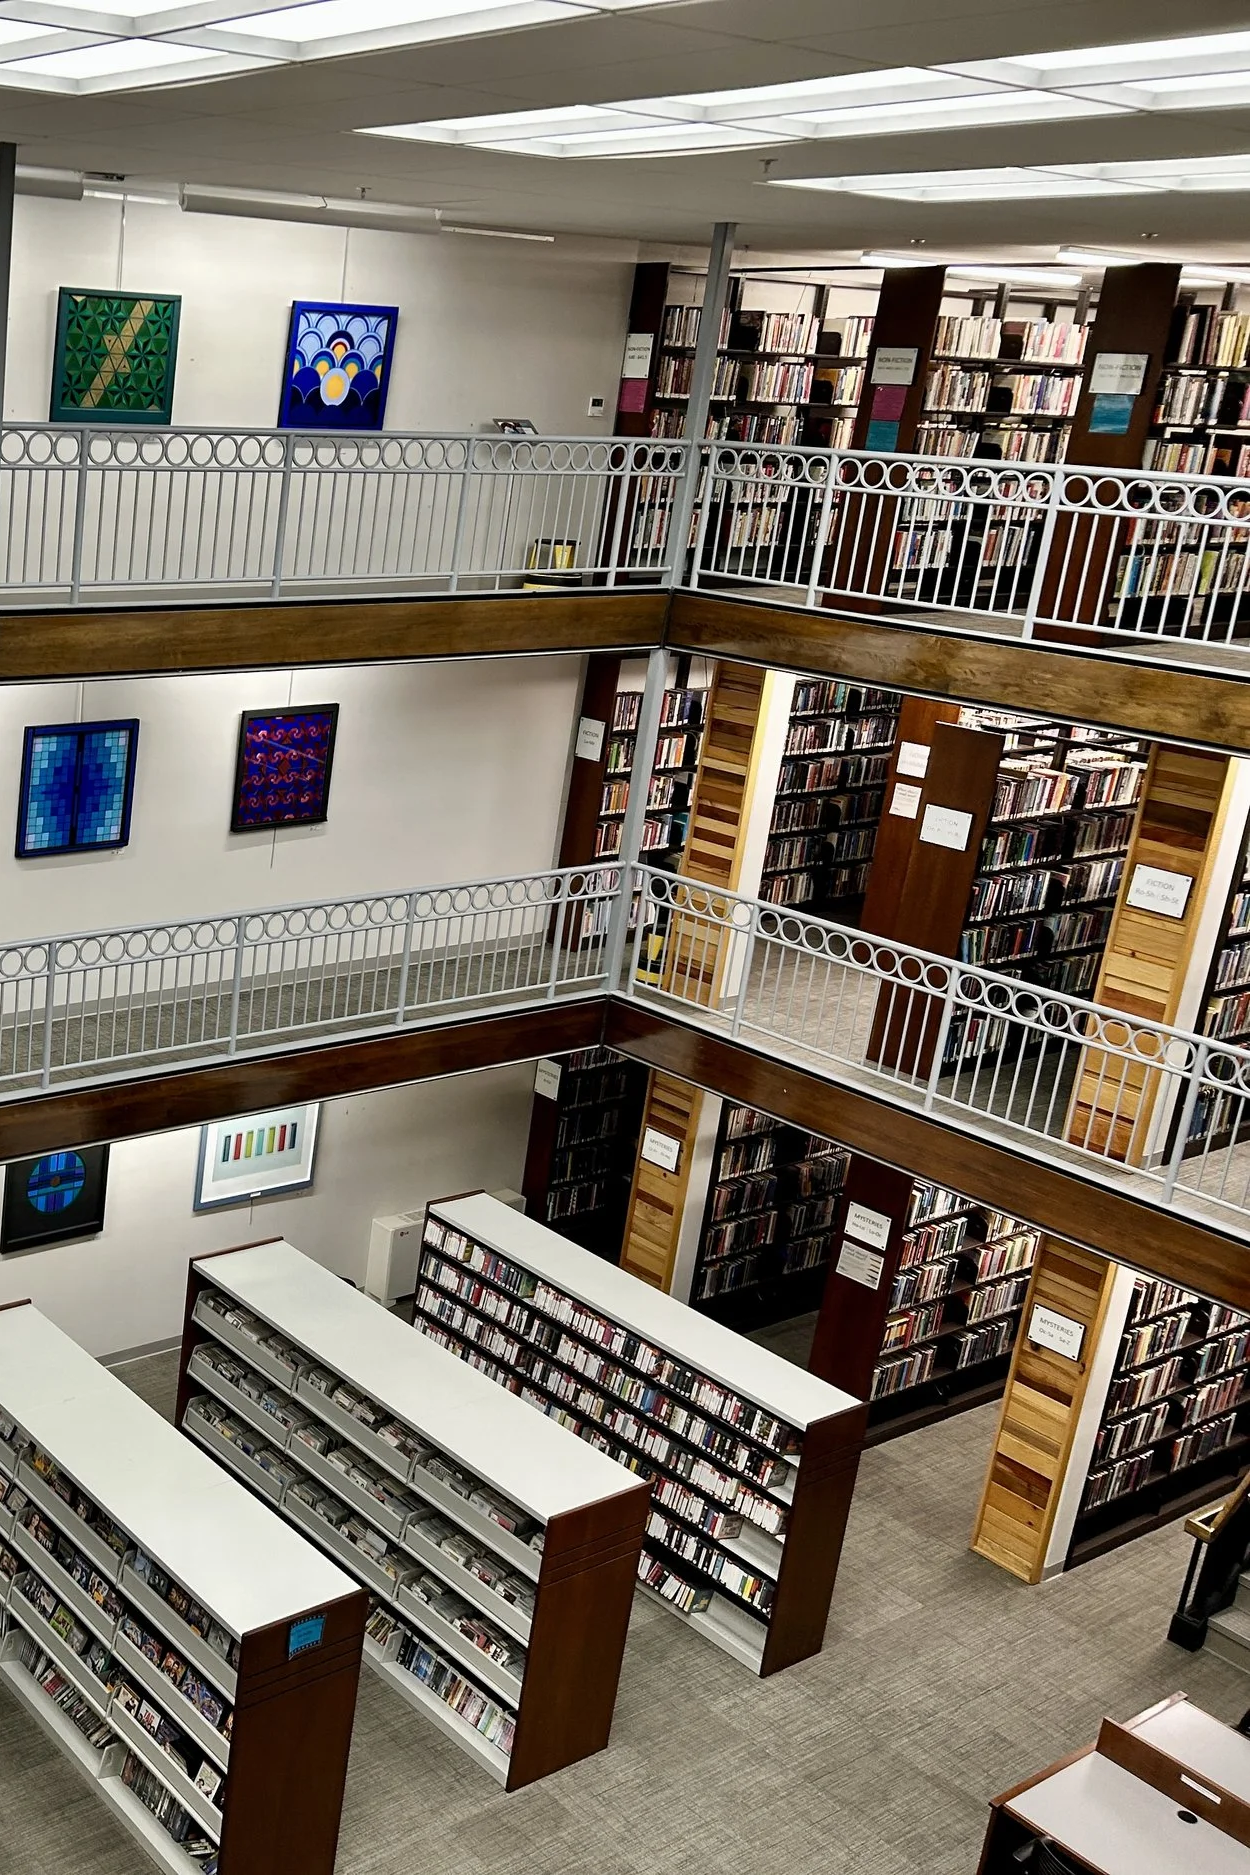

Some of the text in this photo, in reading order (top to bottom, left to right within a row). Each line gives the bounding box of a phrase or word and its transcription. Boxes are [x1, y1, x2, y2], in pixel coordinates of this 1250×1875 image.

[877, 356, 913, 364] NON-FICTION
[1146, 878, 1175, 892] FICTION
[854, 1213, 883, 1230] MYSTERIES
[1039, 1317, 1074, 1337] MYSTERIES
